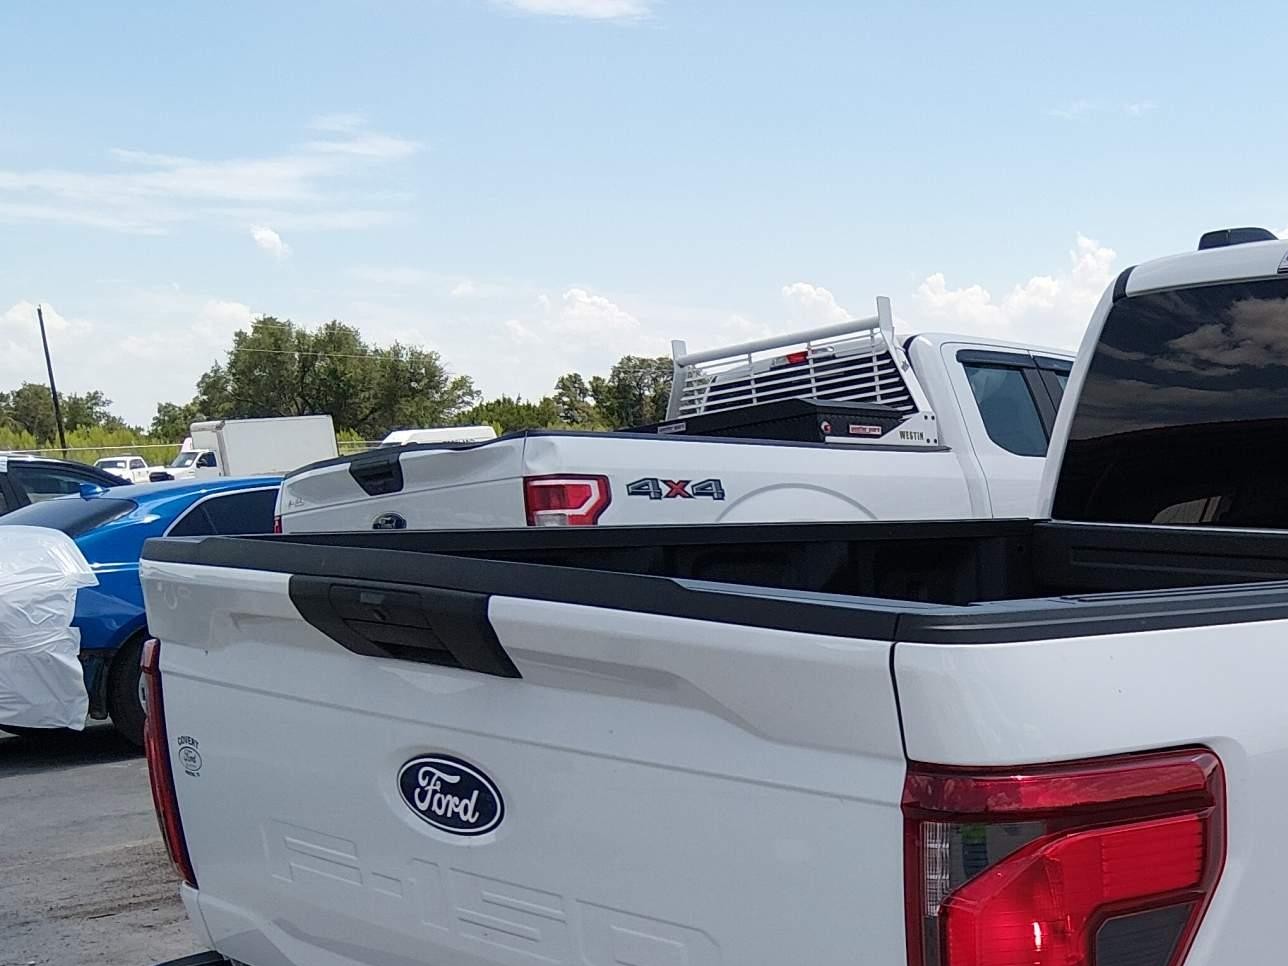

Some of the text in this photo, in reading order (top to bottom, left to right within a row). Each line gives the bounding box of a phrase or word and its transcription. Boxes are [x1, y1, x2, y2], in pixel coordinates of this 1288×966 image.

[899, 430, 925, 441] WESTIN
[177, 735, 200, 750] COVERT
[414, 766, 480, 823] Ford
